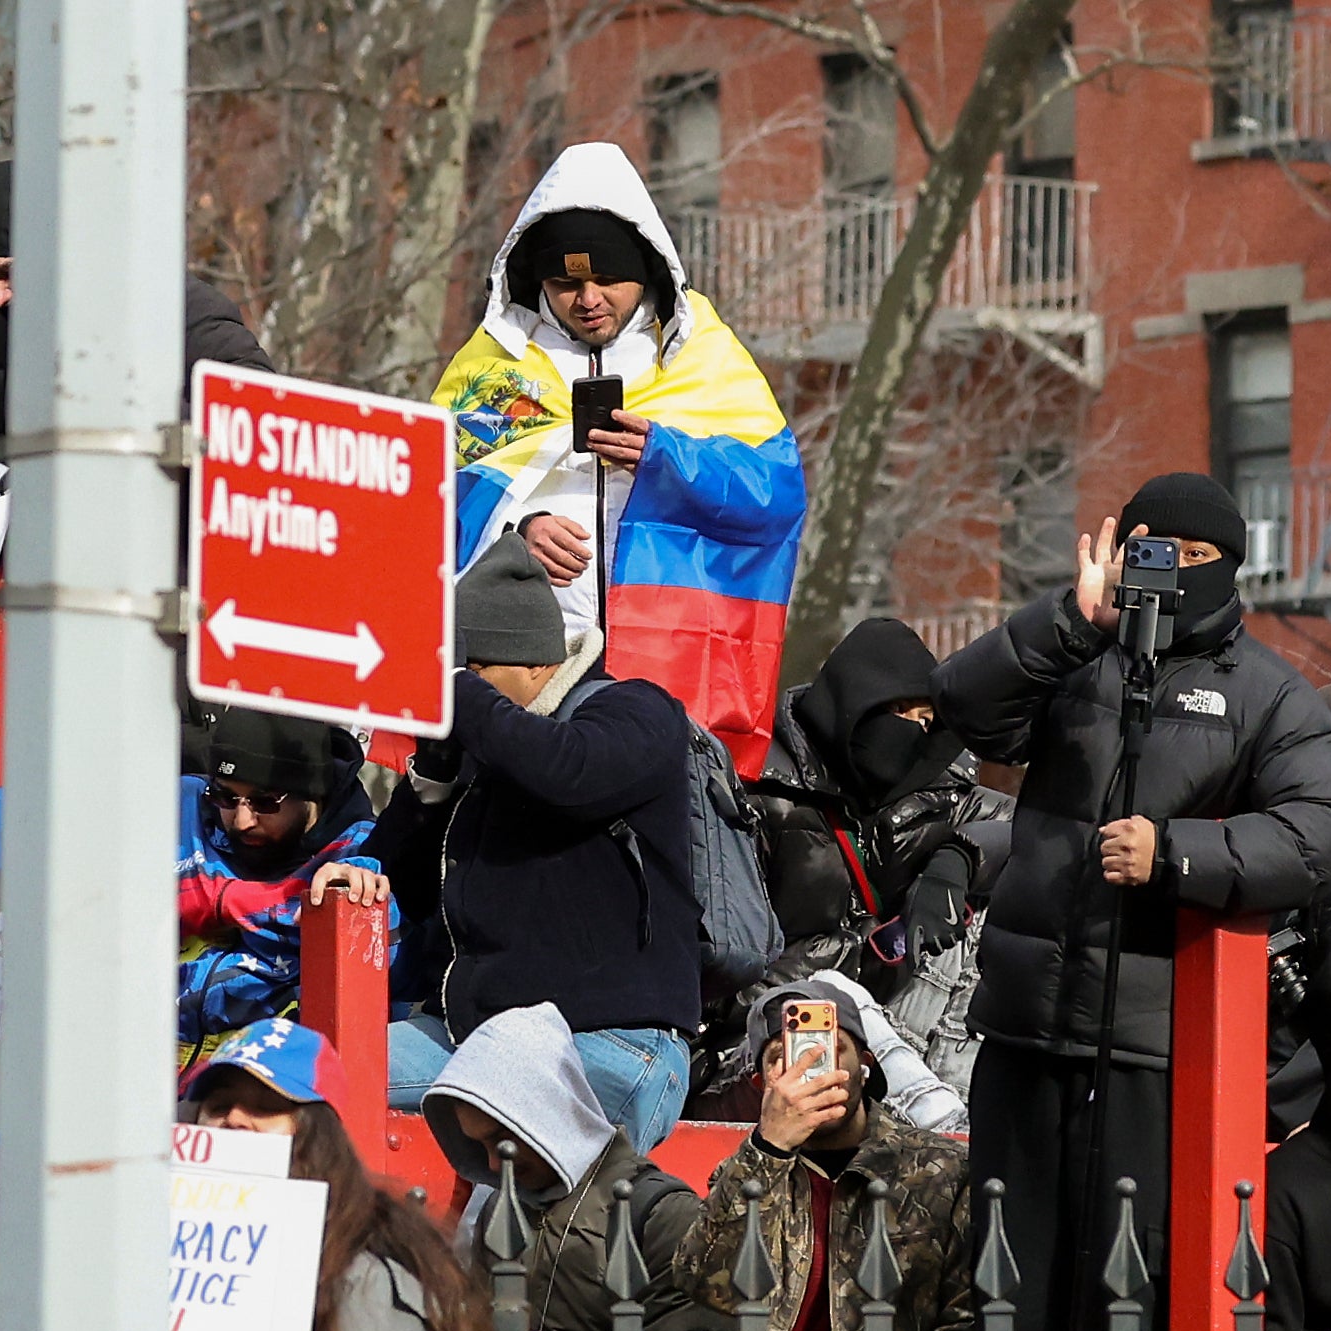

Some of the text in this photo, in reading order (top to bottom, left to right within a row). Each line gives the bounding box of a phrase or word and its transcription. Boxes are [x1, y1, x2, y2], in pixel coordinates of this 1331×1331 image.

[208, 402, 411, 497] NO STANDING
[208, 477, 338, 556] Anytime
[1177, 692, 1212, 706] NORTH
[1184, 702, 1212, 713] FACE
[1193, 688, 1212, 698] THE
[170, 1220, 268, 1266] RACY
[170, 1267, 252, 1306] TICE
